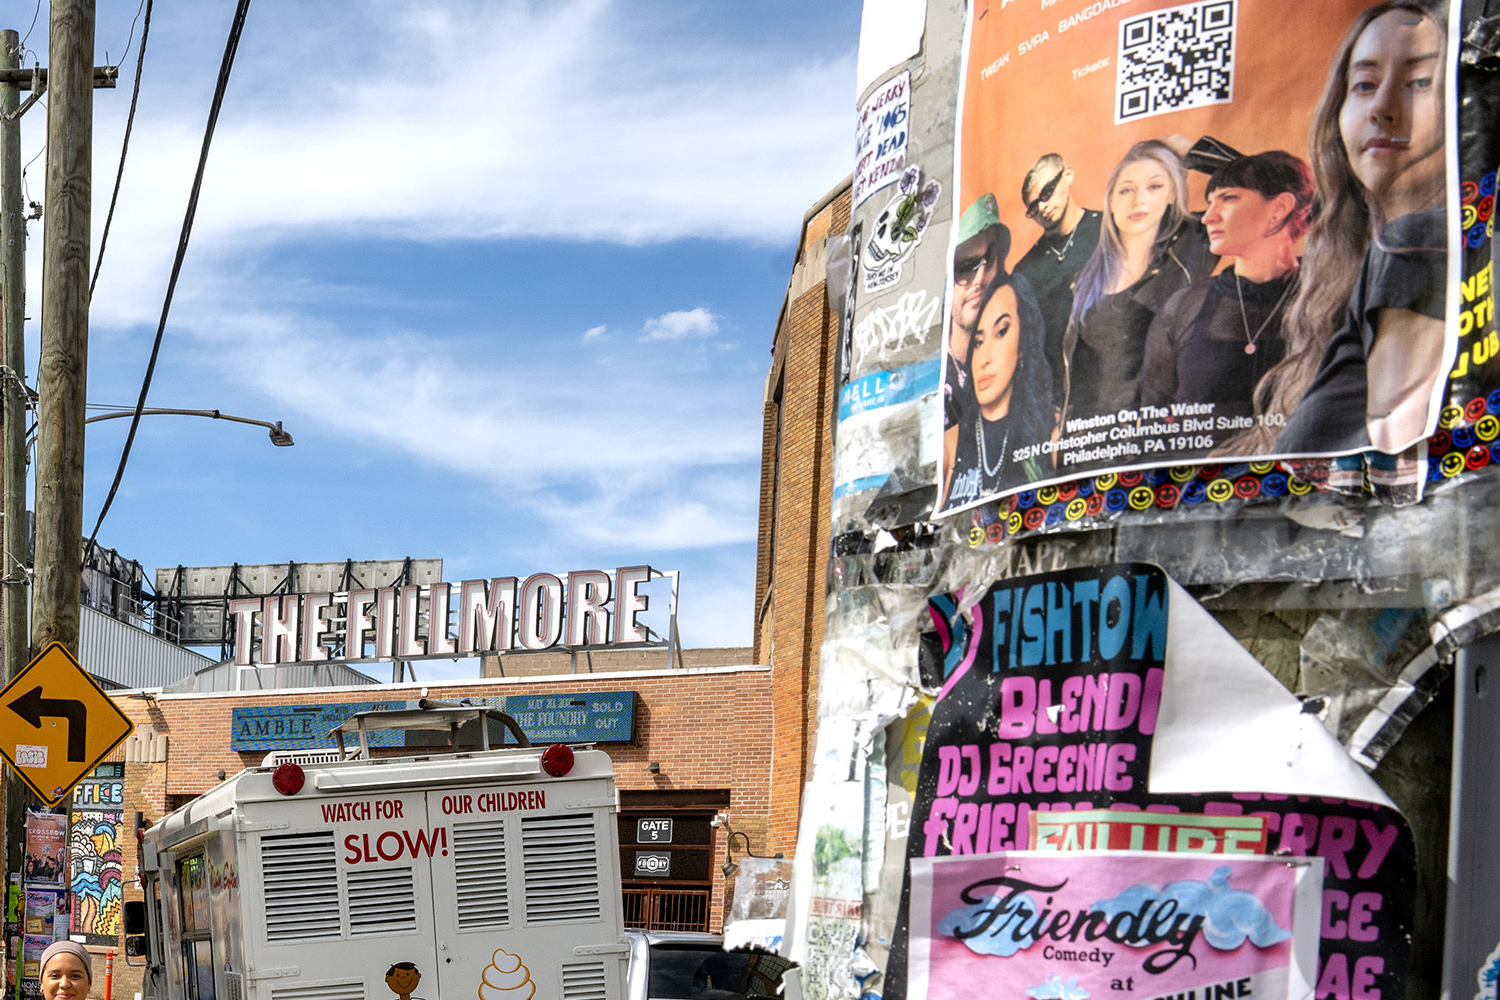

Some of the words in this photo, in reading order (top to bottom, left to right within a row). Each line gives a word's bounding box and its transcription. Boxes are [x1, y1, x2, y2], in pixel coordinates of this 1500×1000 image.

[1066, 414, 1116, 434] Winston
[1118, 409, 1138, 423] On
[1140, 405, 1169, 419] The
[1171, 402, 1215, 417] Water
[1012, 449, 1031, 463] 325
[1030, 444, 1041, 457] N
[1041, 431, 1108, 455] Christopher
[1109, 422, 1180, 440] Columbus
[1183, 418, 1214, 432] Blvd
[1216, 415, 1253, 429] Suite
[1256, 413, 1287, 428] 100,
[1063, 442, 1142, 466] Philadelphia,
[1143, 440, 1165, 452] PA
[1168, 435, 1214, 450] 19106
[229, 592, 334, 666] THE
[345, 565, 651, 660] FILLMORE
[592, 702, 623, 713] SOLD
[239, 716, 314, 737] AMBLE
[595, 718, 618, 729] OUT
[936, 745, 981, 797] DJ
[987, 743, 1137, 796] GREENIE
[321, 800, 371, 823] WATCH
[375, 799, 404, 820] FOR
[441, 795, 474, 815] OUR
[477, 790, 546, 813] CHILDREN
[28, 828, 66, 837] CROSSBOW
[641, 820, 670, 831] GATE
[651, 831, 659, 841] 5
[344, 827, 449, 865] SLOW!
[638, 859, 668, 869] FOUNDRY
[954, 876, 1207, 974] Friendly
[1043, 945, 1115, 968] Comedy
[1110, 976, 1135, 992] at
